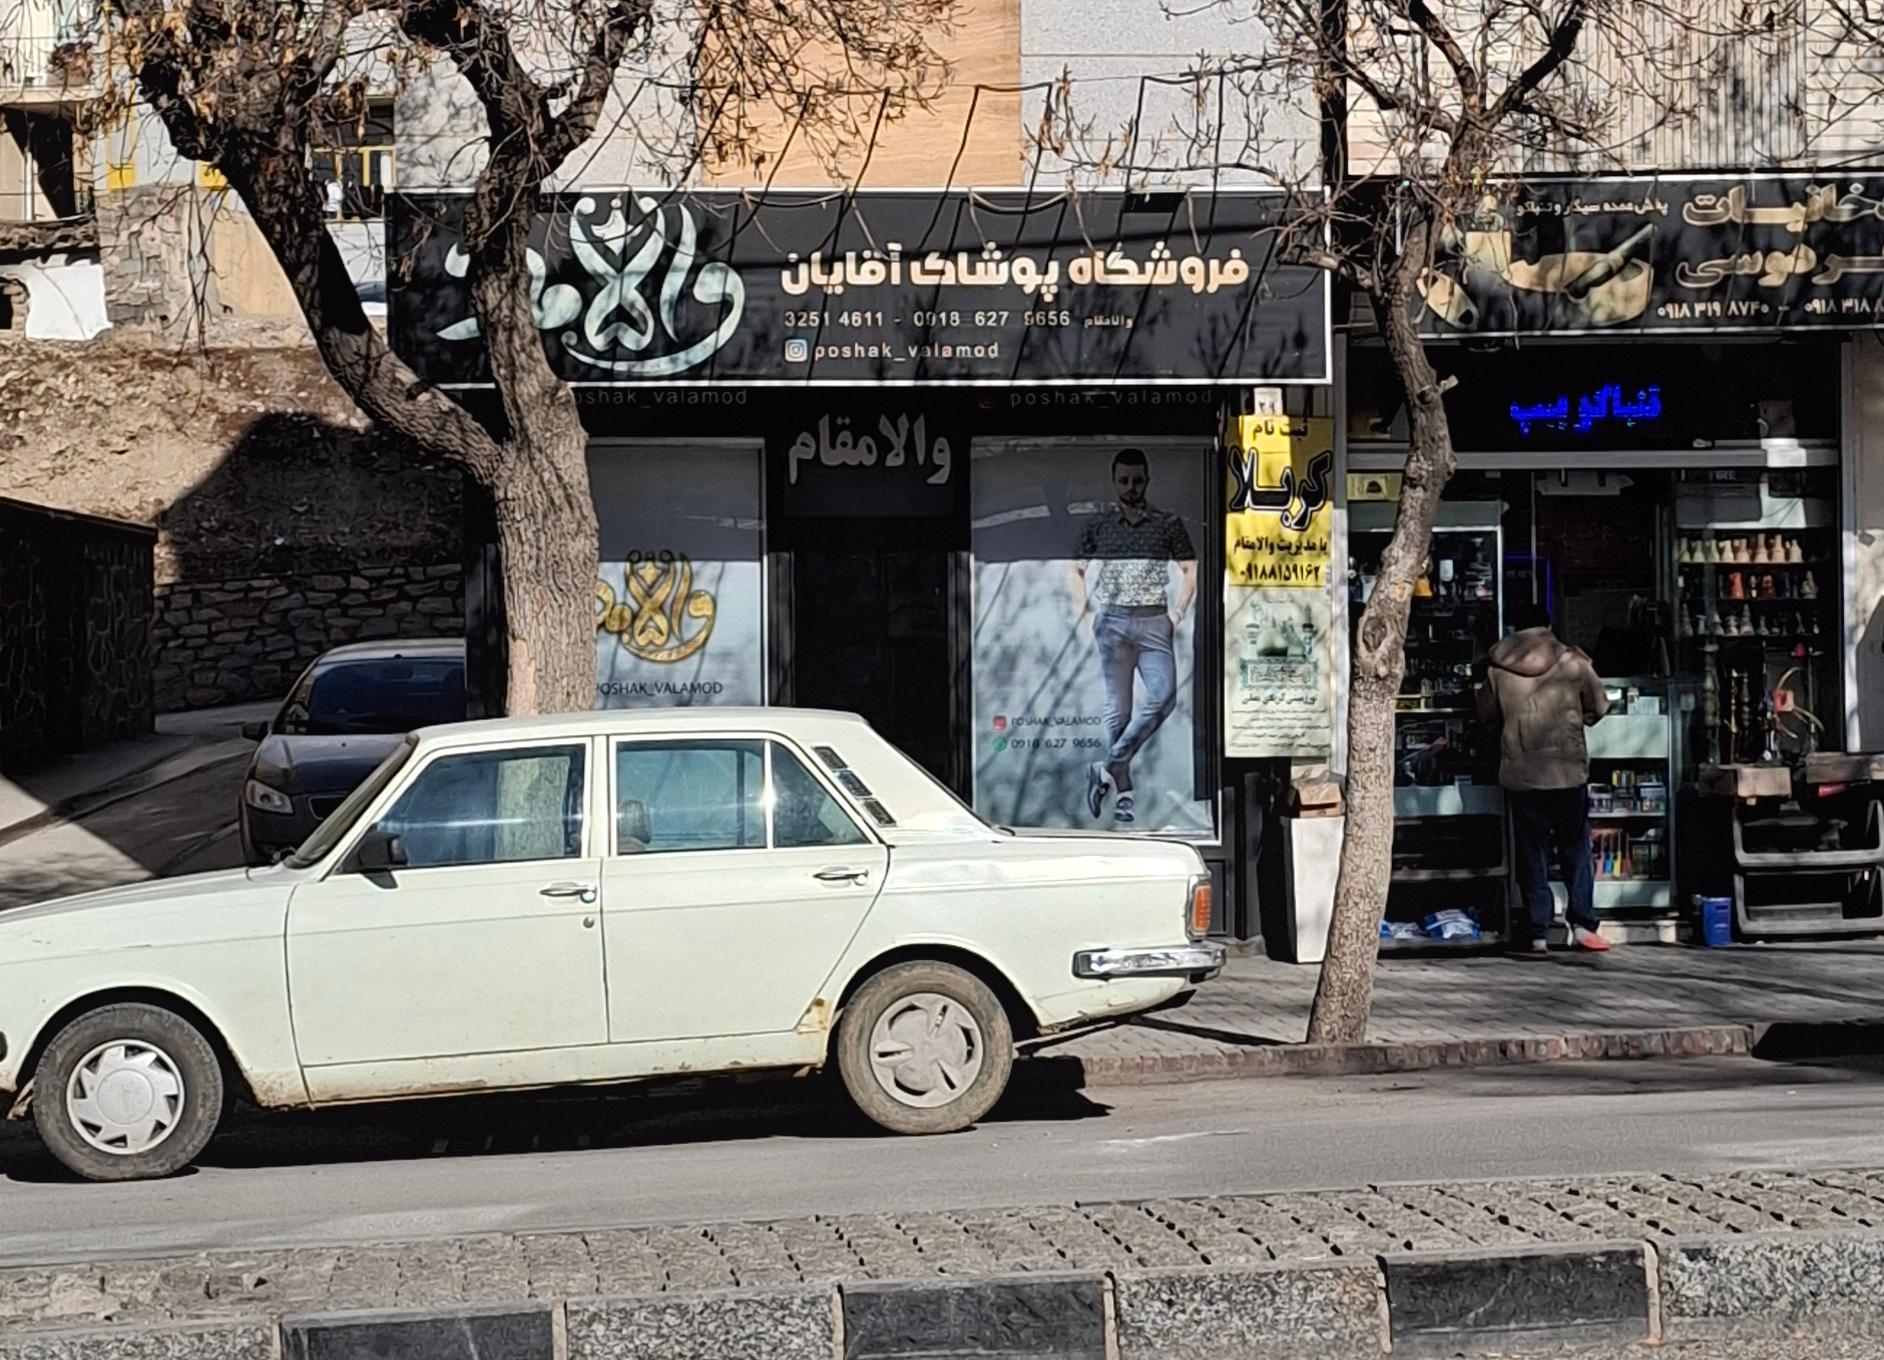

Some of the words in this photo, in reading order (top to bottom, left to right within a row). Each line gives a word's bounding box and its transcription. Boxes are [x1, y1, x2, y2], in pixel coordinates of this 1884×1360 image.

[1562, 196, 1601, 216] سیگار
[1603, 200, 1634, 213] عمده
[1683, 183, 1884, 232] خانیات
[781, 242, 902, 296] آقایان
[910, 241, 1059, 303] پوشاک
[1068, 240, 1249, 294] فروشگاه
[785, 311, 830, 328] 3251
[838, 311, 883, 328] 4611
[913, 311, 961, 328] 0918
[975, 311, 1010, 328] 627
[1024, 311, 1070, 327] 9656
[815, 342, 999, 362] poshak_valamod
[1010, 390, 1213, 409] poshak_valamod
[1253, 420, 1275, 441] نام
[789, 412, 951, 485] والامقام
[1227, 445, 1333, 532] کربلا
[1234, 535, 1275, 556] والامقام
[1276, 539, 1317, 556] مدیریت
[1045, 739, 1067, 749] 627
[1073, 739, 1101, 749] 9656
